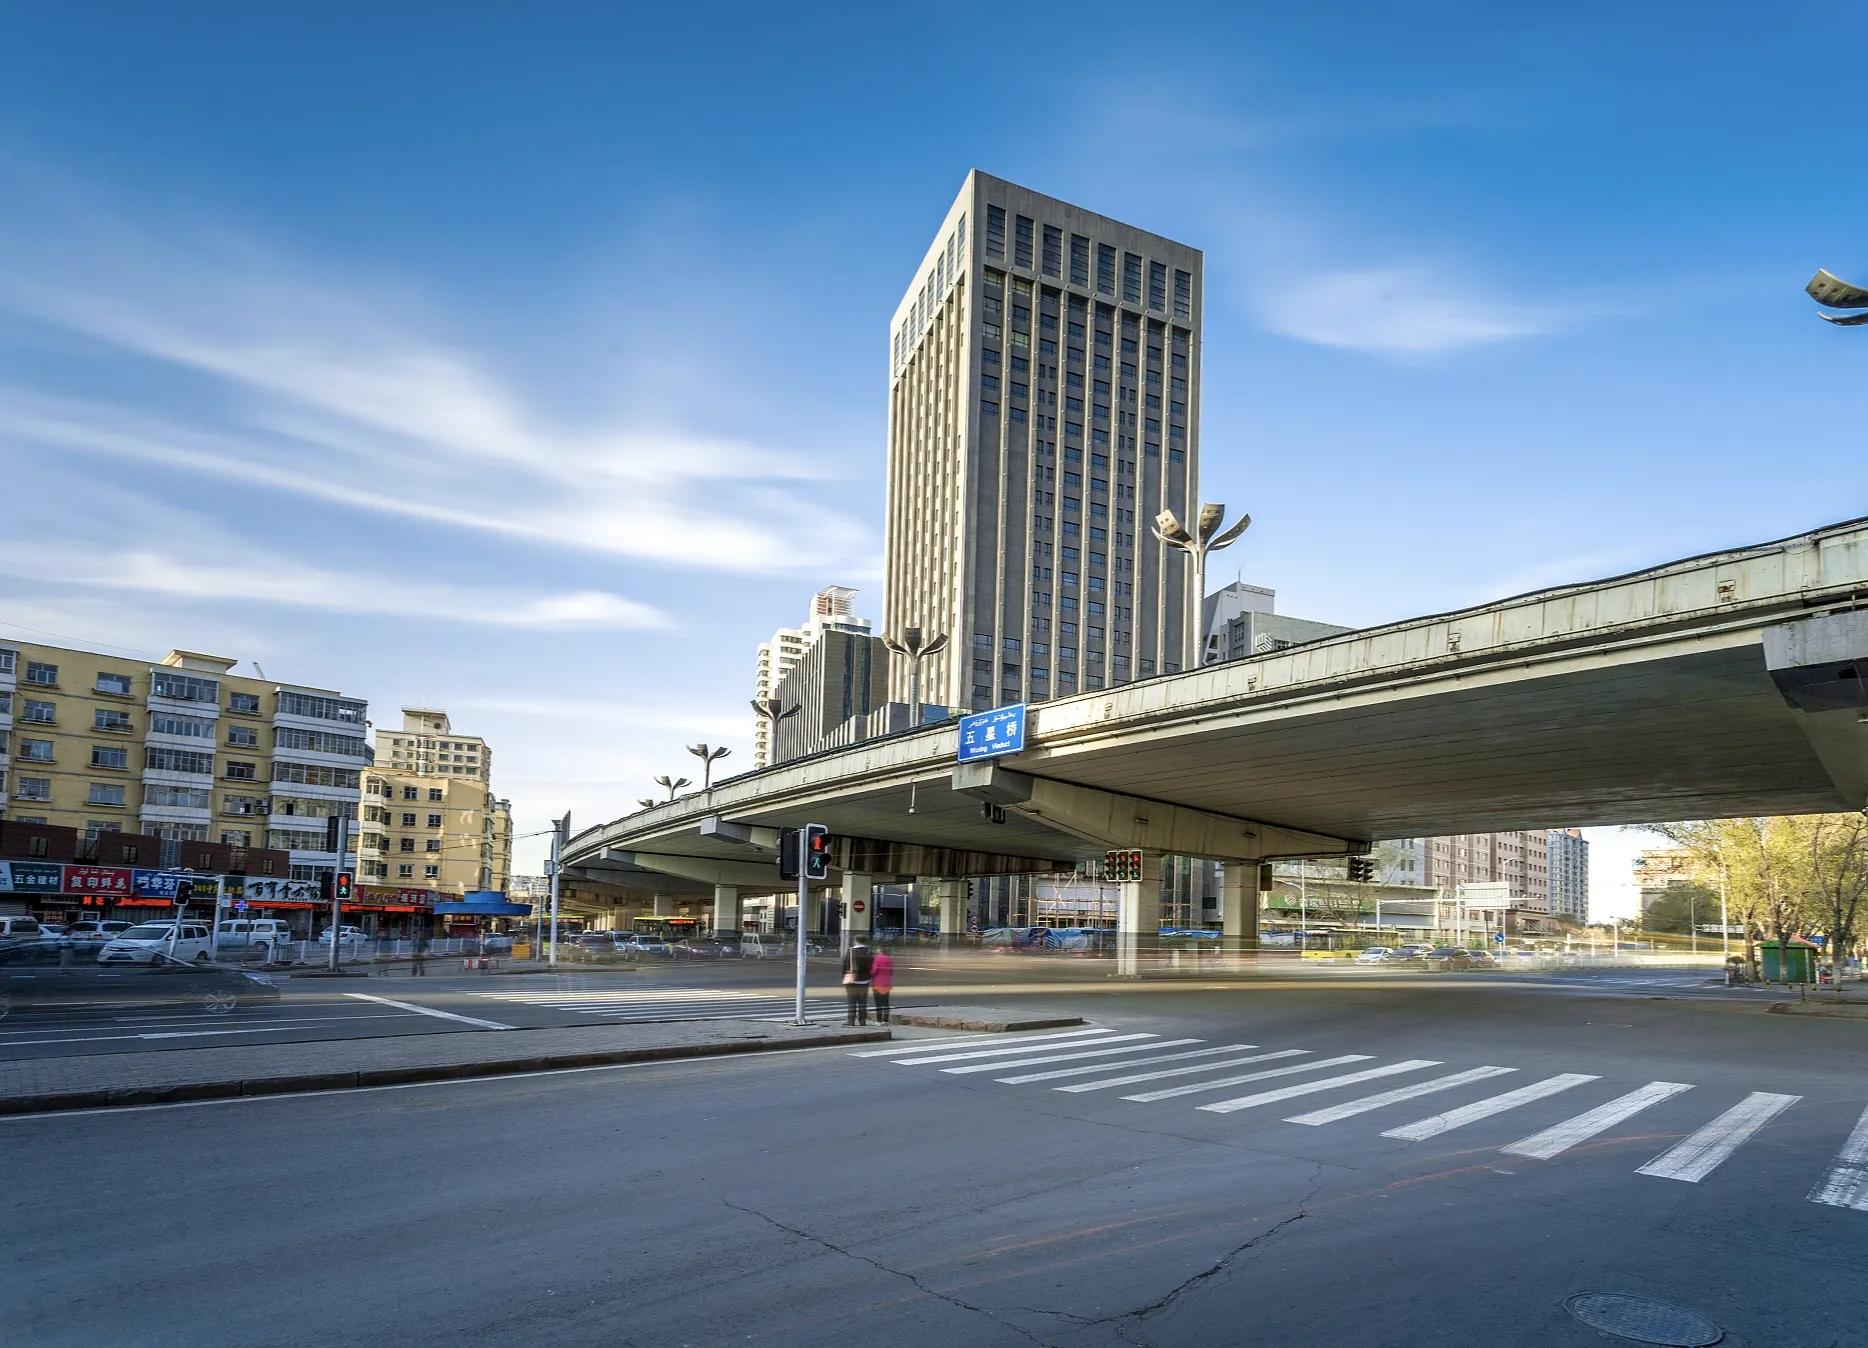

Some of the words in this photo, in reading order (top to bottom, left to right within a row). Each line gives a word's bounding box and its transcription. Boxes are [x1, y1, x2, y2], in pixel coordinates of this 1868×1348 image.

[964, 722, 1017, 744] 五星桥
[992, 741, 1011, 750] Viaduct
[14, 874, 59, 886] 五金建材
